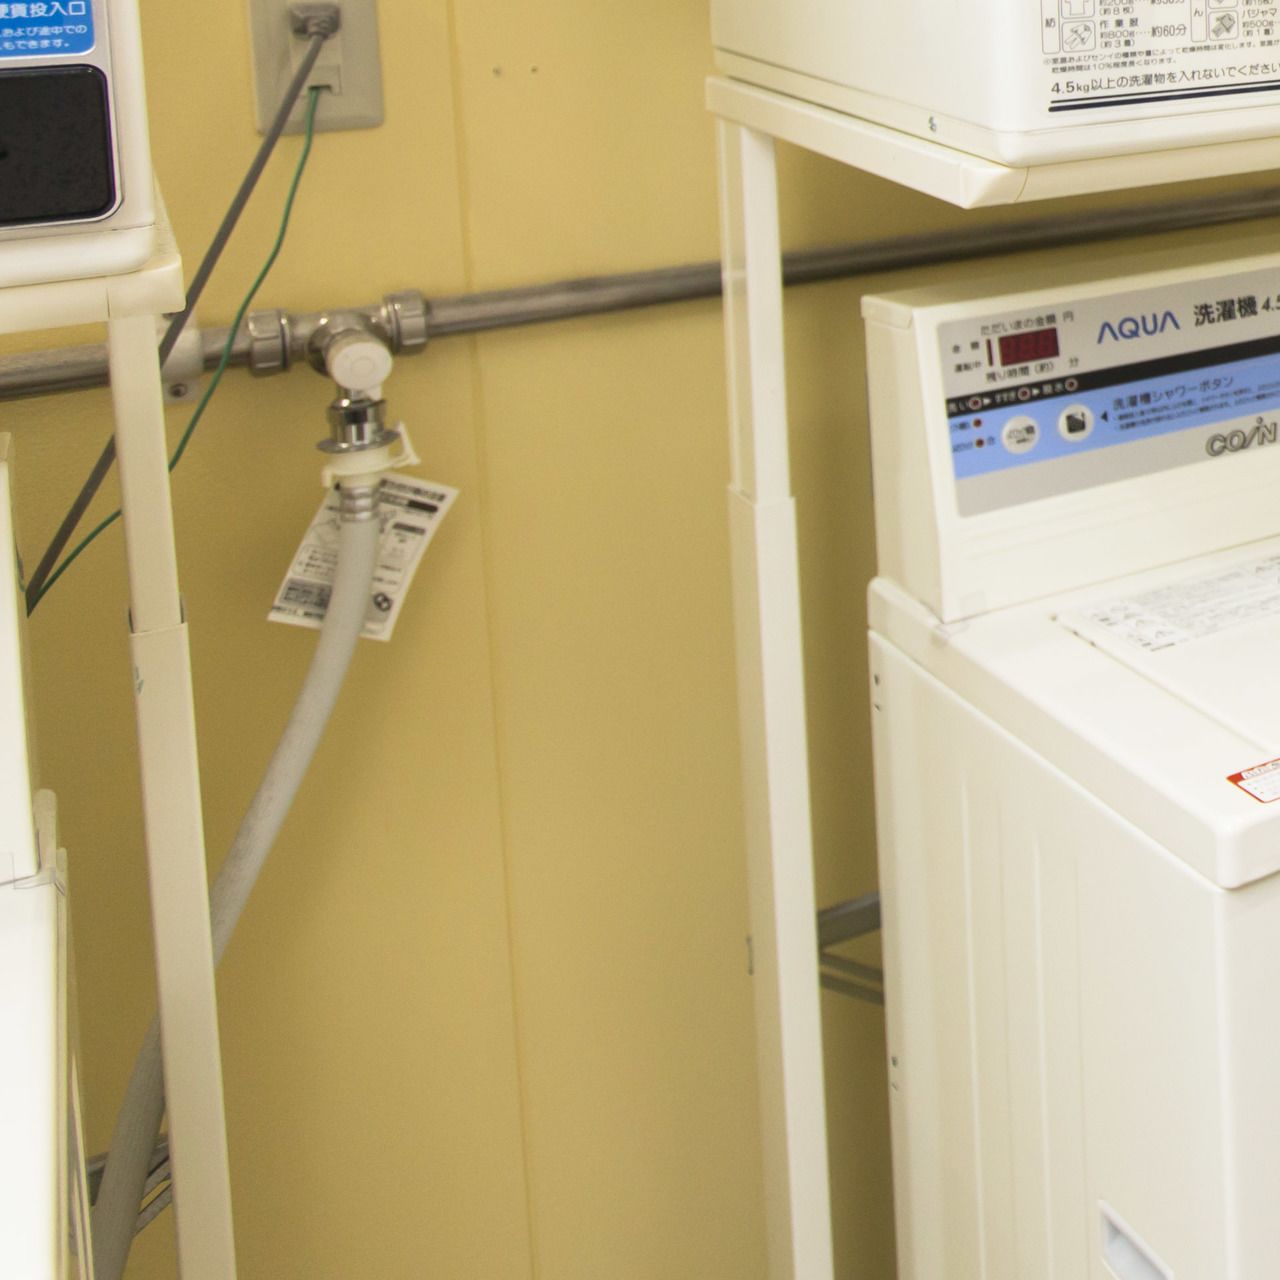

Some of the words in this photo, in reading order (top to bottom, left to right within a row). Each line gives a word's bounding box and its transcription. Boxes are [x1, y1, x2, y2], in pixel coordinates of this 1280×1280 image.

[1151, 23, 1187, 38] 約60分
[1193, 295, 1258, 327] 洗濯機
[1097, 310, 1180, 345] AQUA
